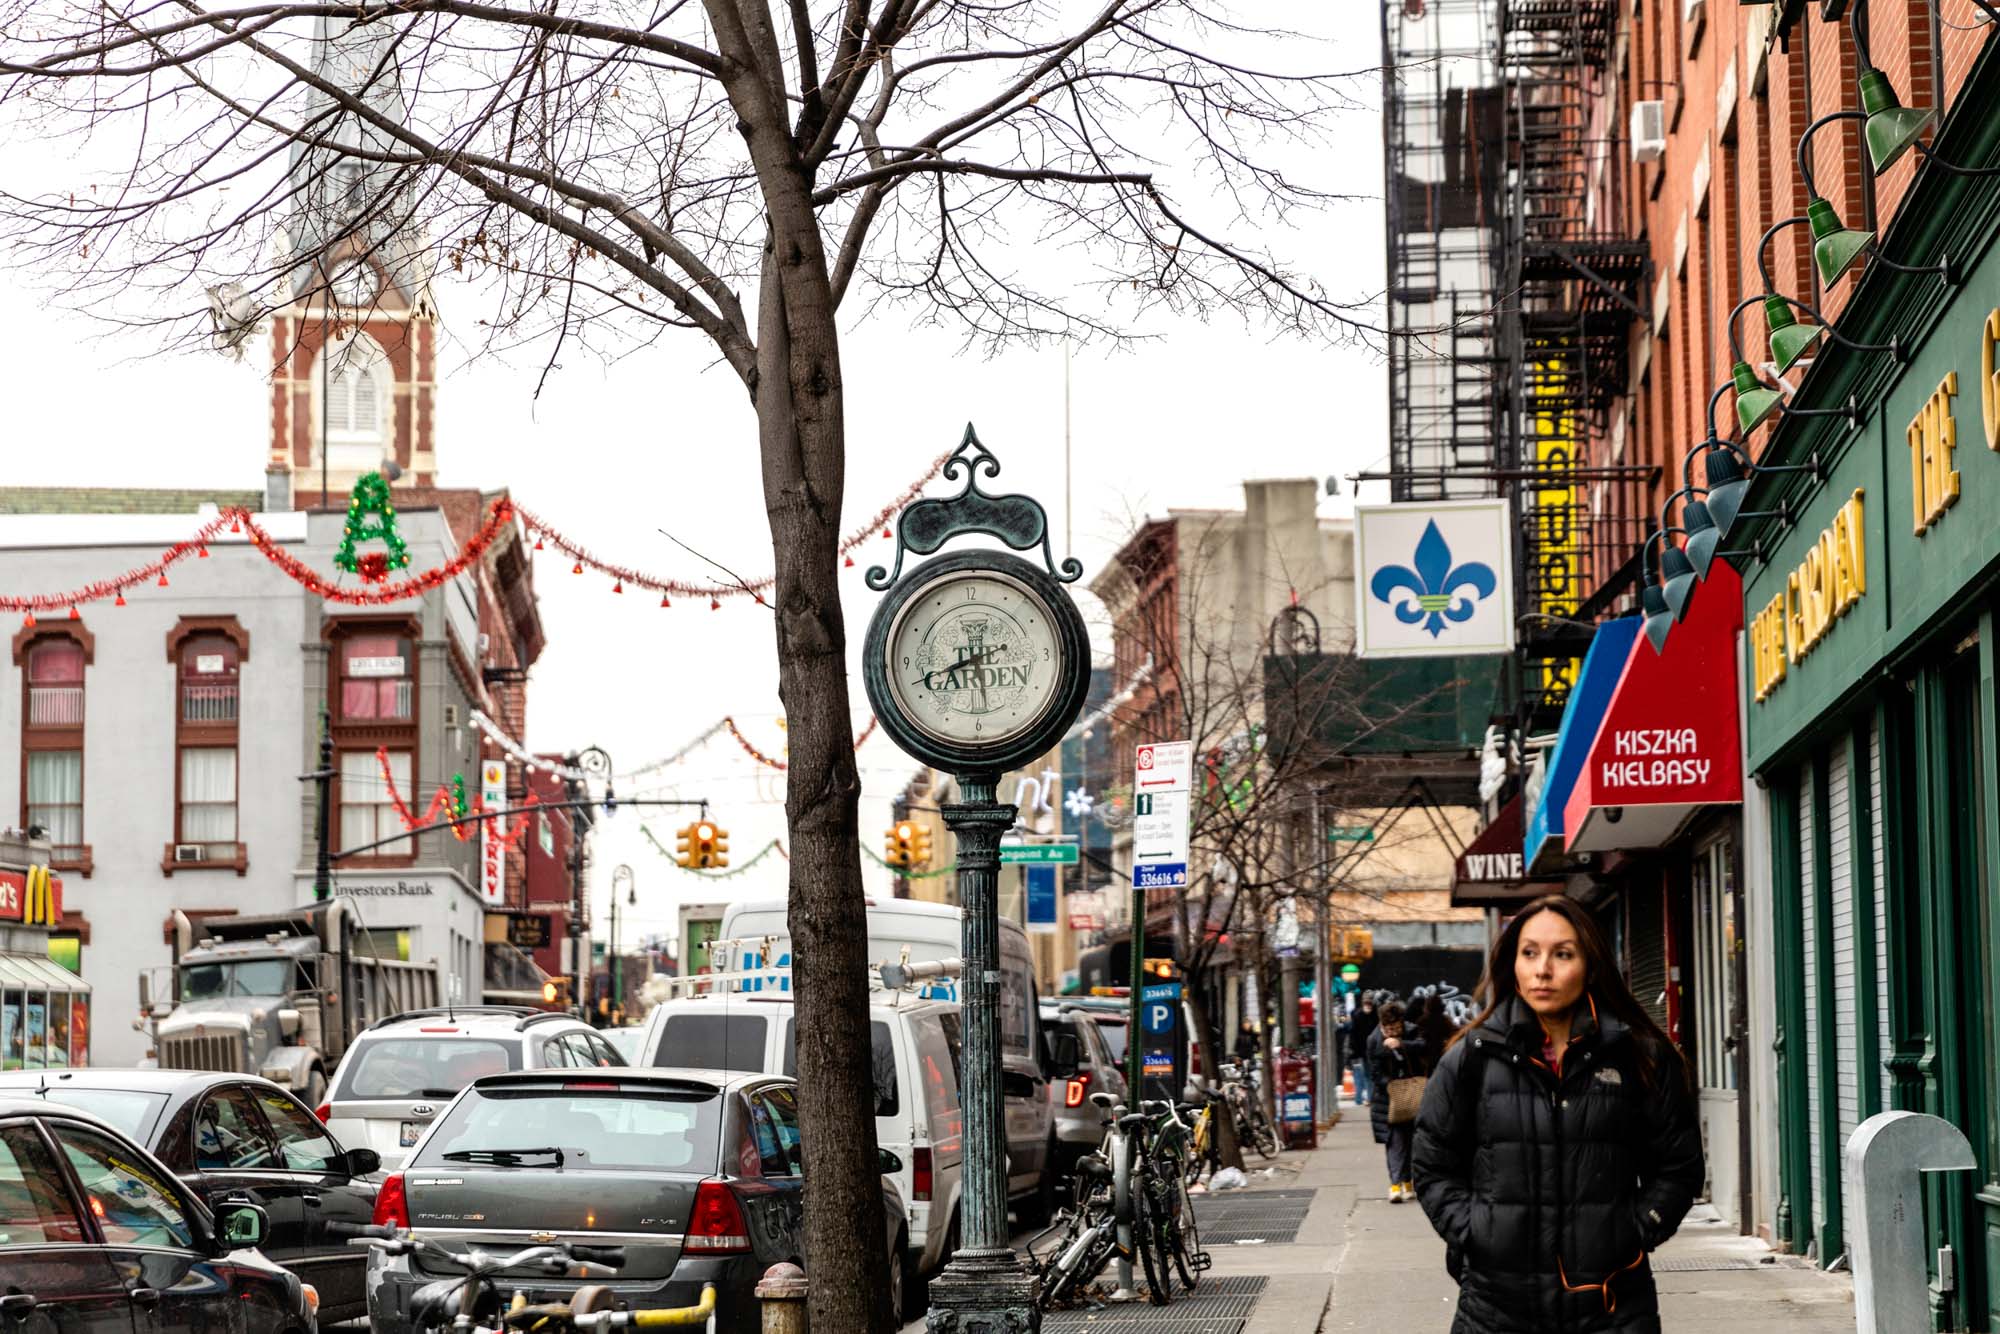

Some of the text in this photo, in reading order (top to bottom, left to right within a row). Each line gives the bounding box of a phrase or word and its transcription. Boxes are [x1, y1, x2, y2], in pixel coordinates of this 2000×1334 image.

[1907, 370, 1960, 537] THE
[966, 586, 976, 600] 12
[1750, 488, 1866, 703] THE GARDEN
[903, 657, 910, 670] 9
[953, 644, 1000, 666] THE
[1043, 648, 1050, 661] 3
[924, 665, 1028, 691] GARDEN
[975, 718, 982, 732] 6
[1615, 728, 1697, 756] KISZKA
[1602, 758, 1711, 788] KIELBASY
[1466, 853, 1523, 881] WINE
[397, 880, 433, 896] Bank
[1140, 872, 1172, 886] 336616
[1152, 1005, 1169, 1030] P
